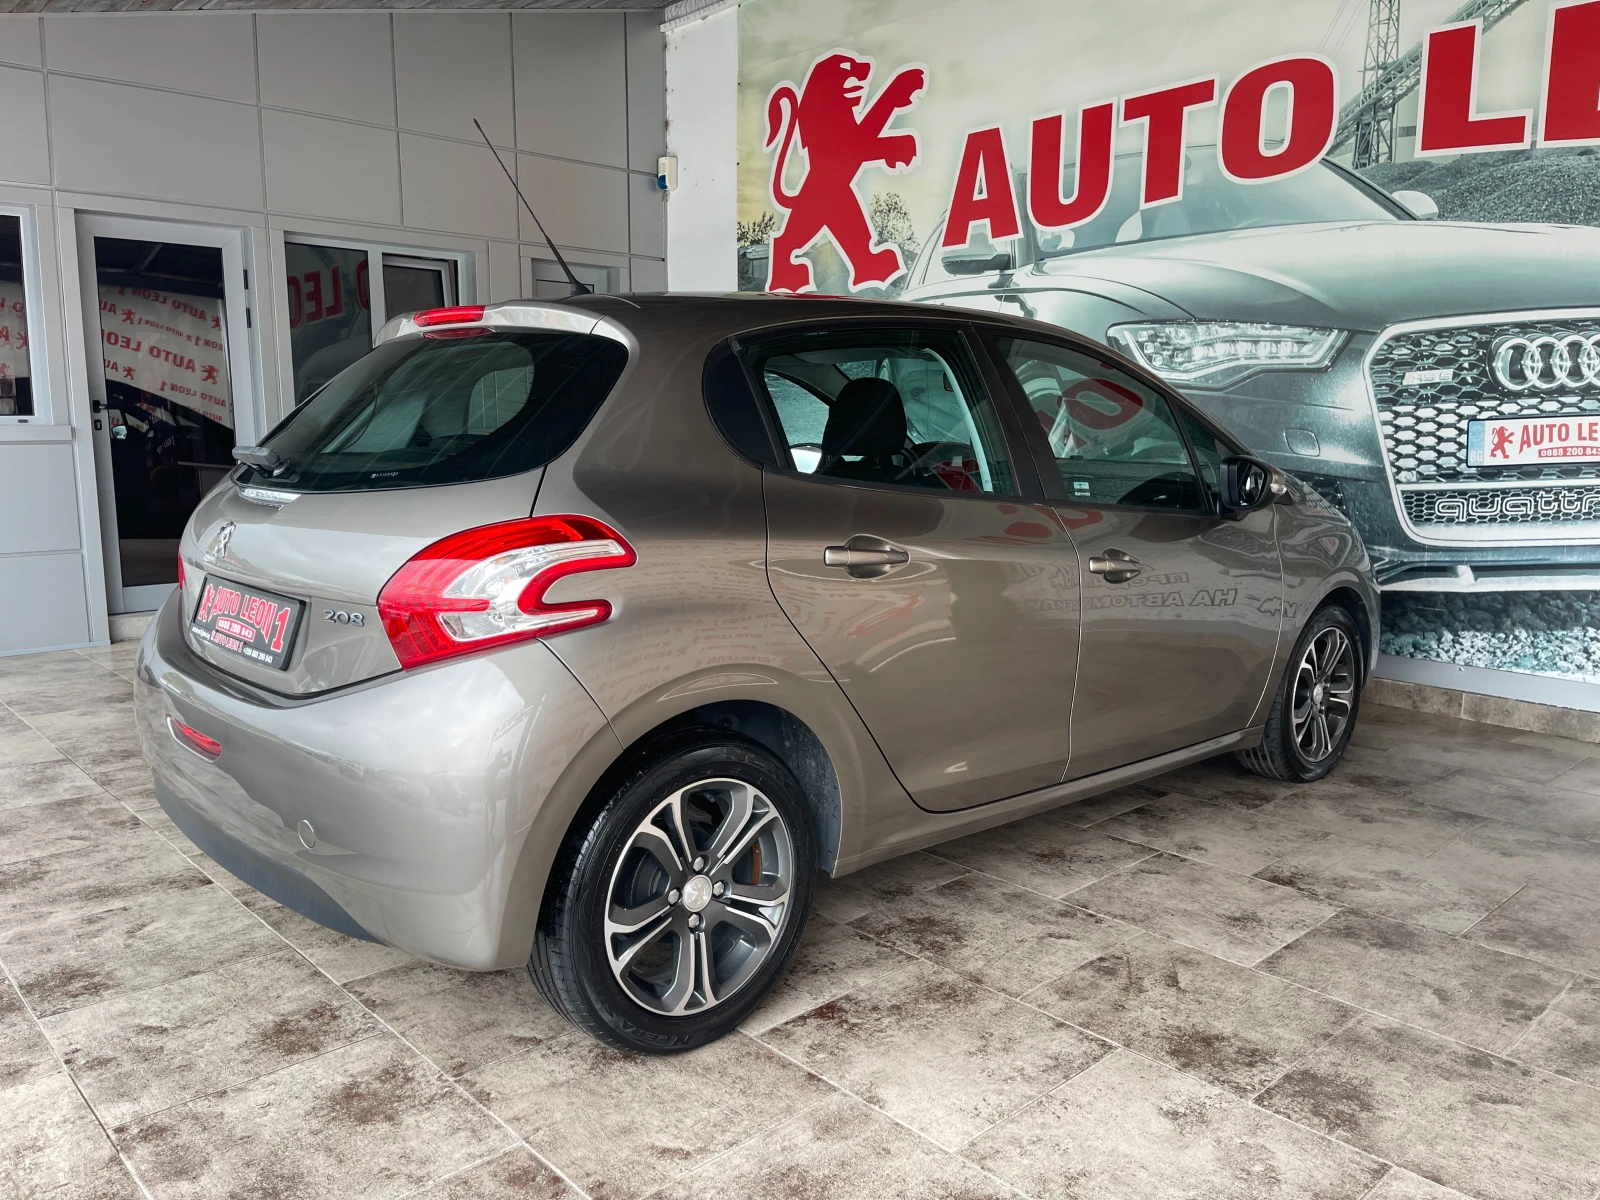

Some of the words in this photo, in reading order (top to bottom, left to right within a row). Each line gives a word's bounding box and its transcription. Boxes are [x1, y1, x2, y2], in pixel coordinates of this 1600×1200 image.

[940, 54, 1338, 249] AUTO
[1518, 423, 1570, 454] AUTO
[1470, 450, 1484, 462] BG
[1541, 448, 1564, 457] 0888
[1566, 447, 1583, 456] 200
[208, 586, 241, 623] AUTO
[240, 594, 278, 644] LEON
[270, 607, 291, 653] 1
[323, 608, 365, 627] 208
[241, 627, 253, 639] 843
